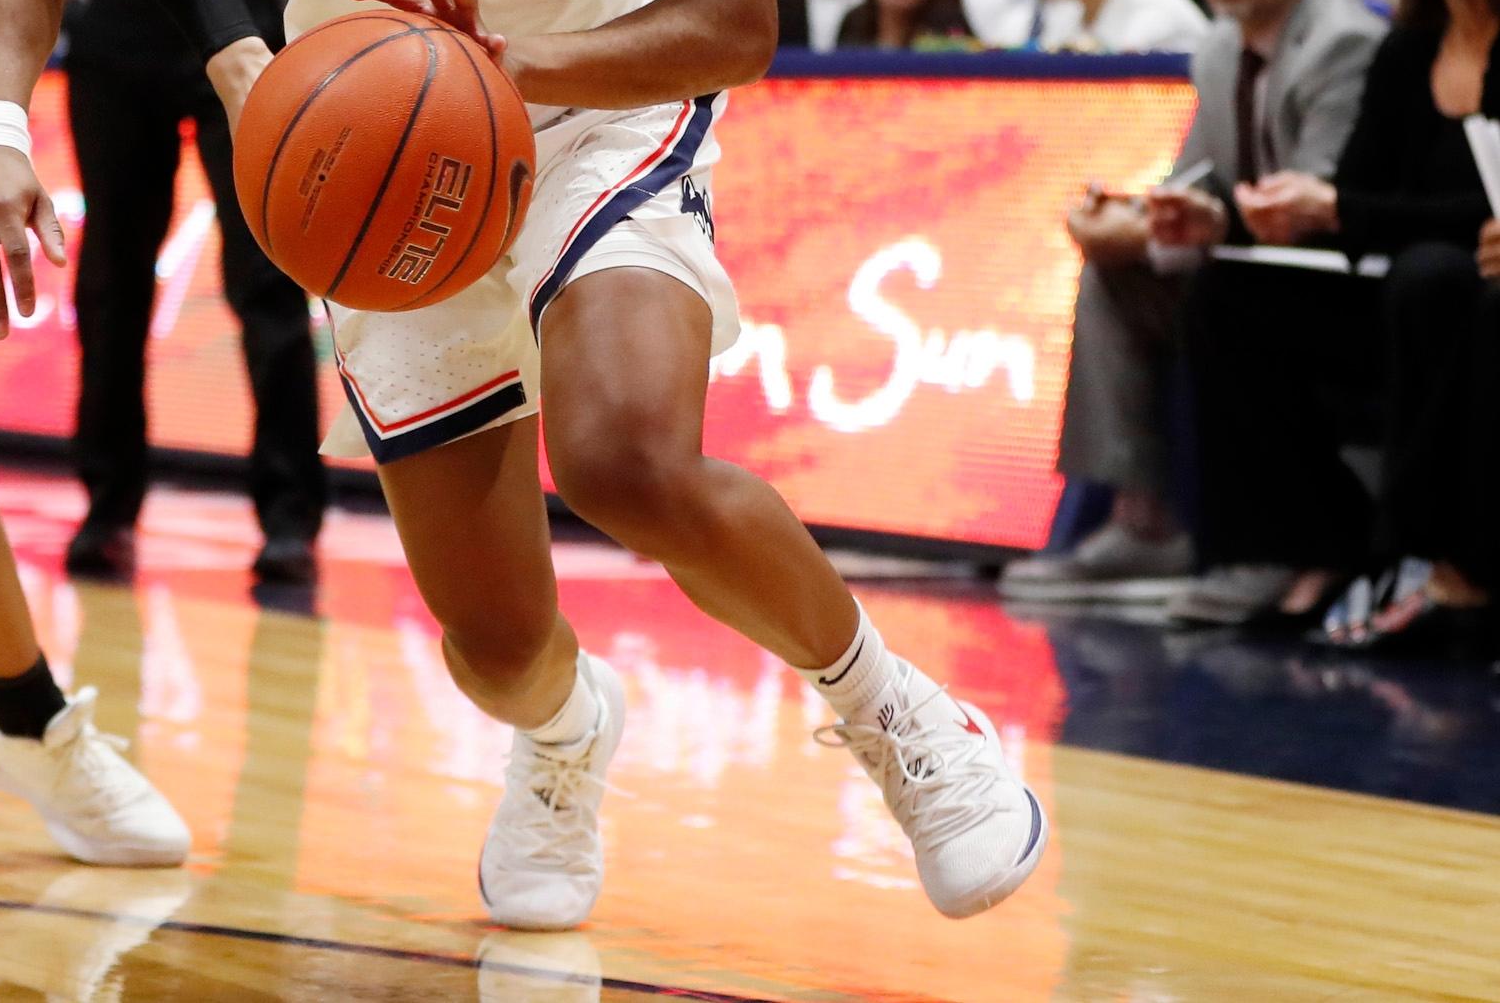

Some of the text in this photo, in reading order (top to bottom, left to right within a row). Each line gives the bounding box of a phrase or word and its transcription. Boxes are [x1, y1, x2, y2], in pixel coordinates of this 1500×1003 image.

[378, 152, 439, 276] CHAMPIONSHIP
[387, 156, 474, 285] ELITE
[806, 236, 1035, 432] Sun
